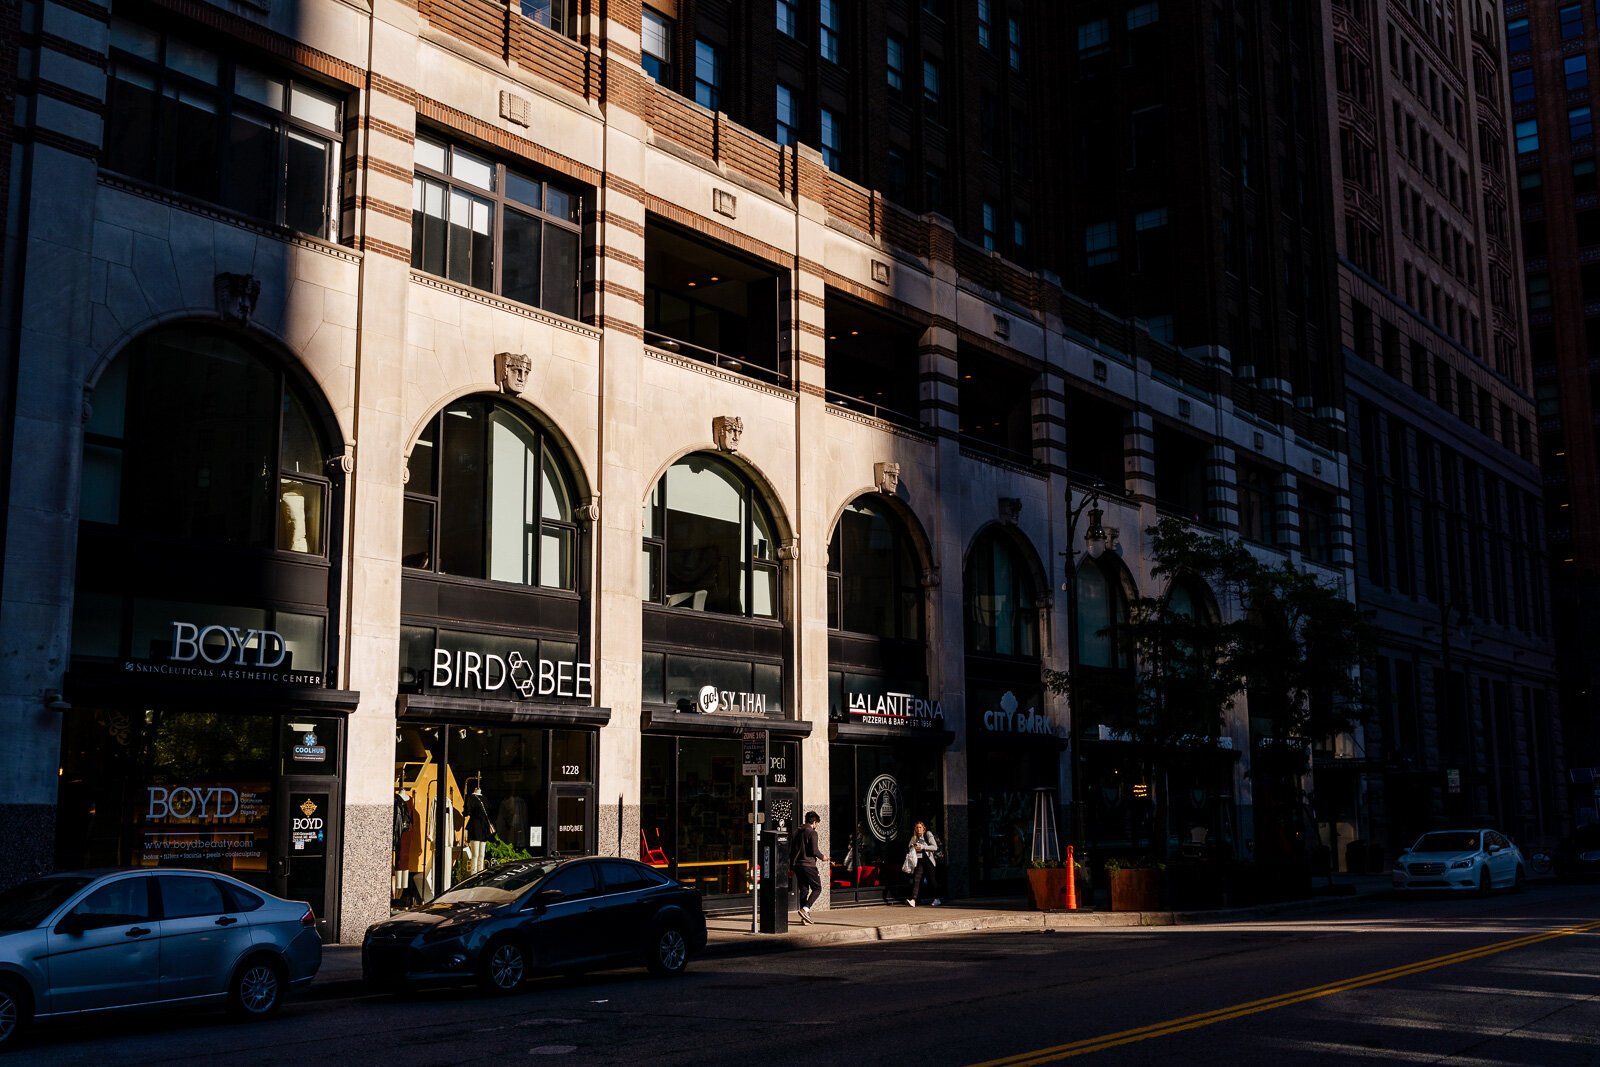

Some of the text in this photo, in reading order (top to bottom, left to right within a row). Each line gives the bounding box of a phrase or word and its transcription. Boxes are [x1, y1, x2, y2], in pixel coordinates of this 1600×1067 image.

[171, 621, 286, 668] BOYD
[220, 671, 279, 682] AESTHETIC
[282, 674, 321, 685] CENTER
[432, 648, 592, 698] BIRD BEE
[703, 687, 718, 710] go!
[720, 690, 766, 713] SY THAI
[862, 715, 888, 725] PIZZERIA
[893, 718, 905, 726] BAR
[983, 709, 1053, 735] CITY BARK
[294, 746, 325, 754] COOLHUB
[561, 765, 580, 775] 1228
[774, 774, 787, 783] 1226
[145, 786, 239, 819] BOYD
[292, 817, 323, 830] BOYD
[143, 839, 254, 851] www.boydbeauty.com
